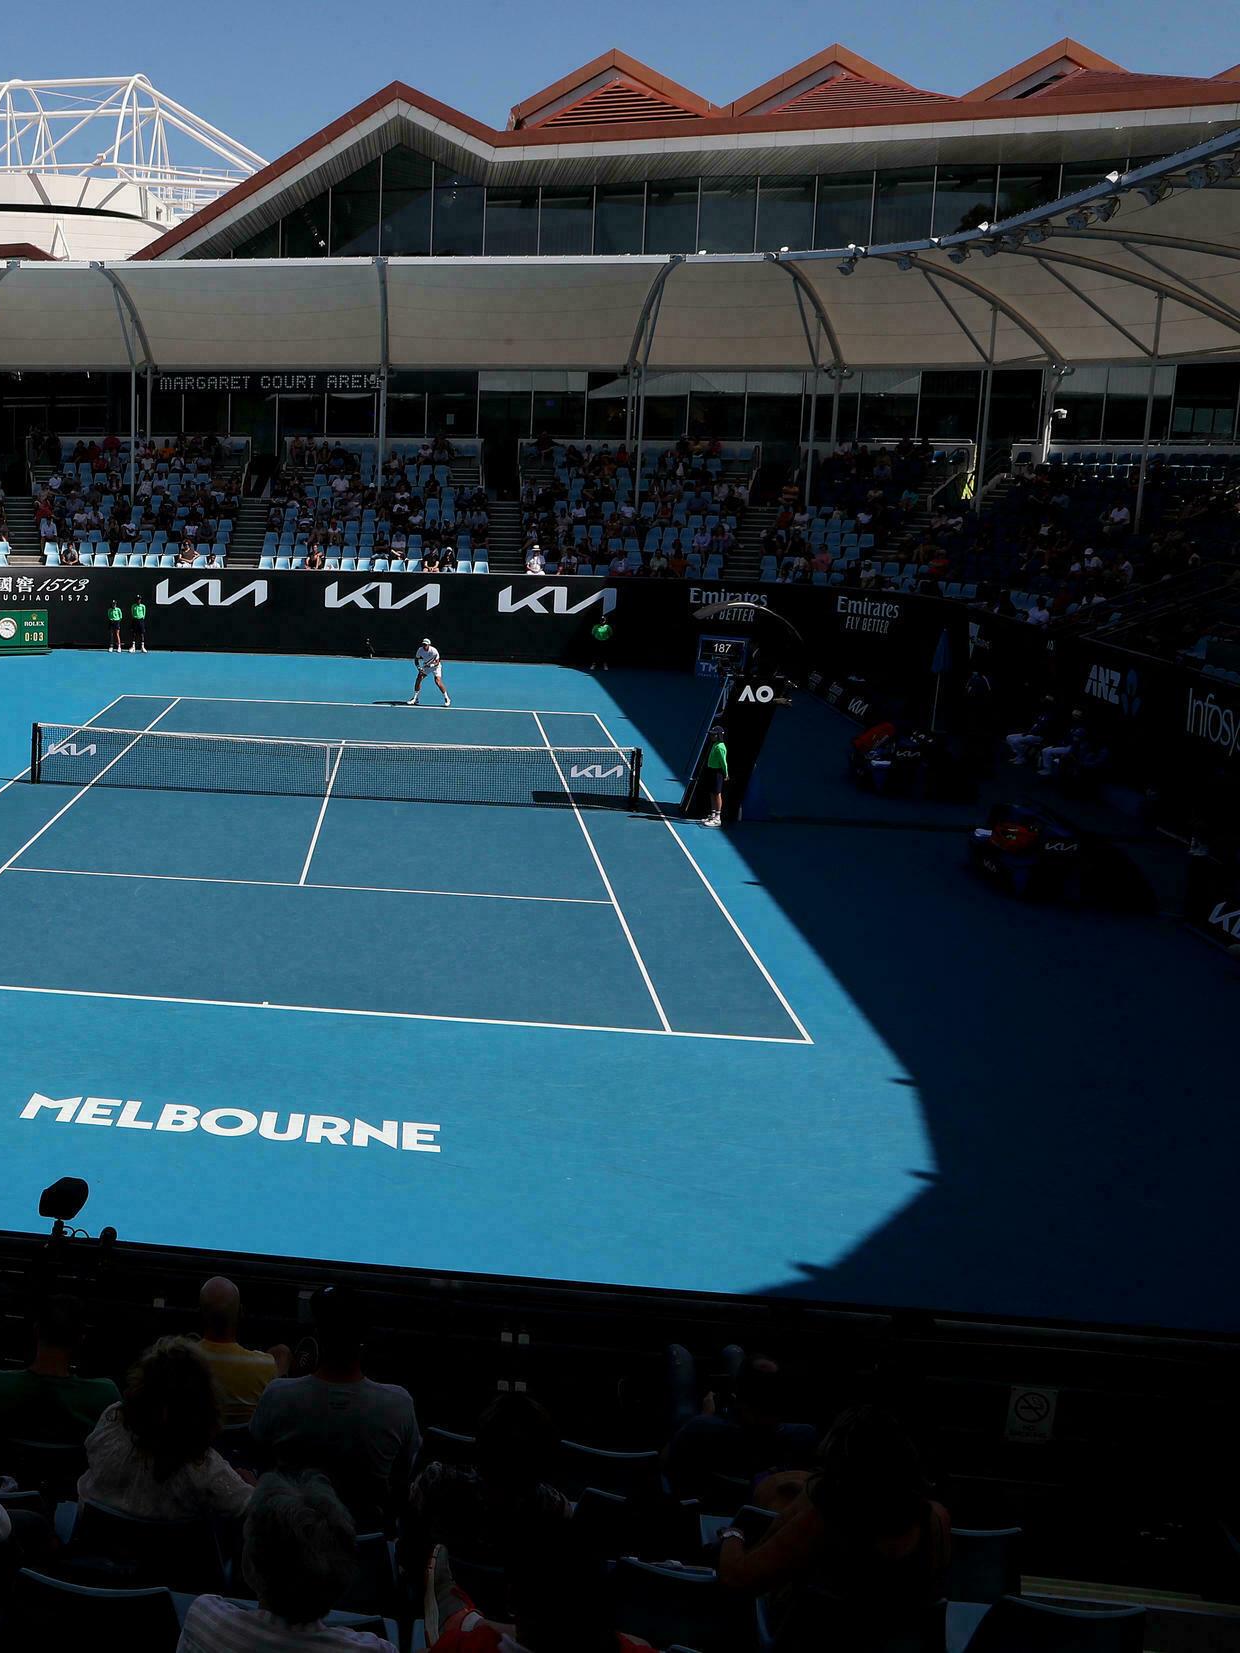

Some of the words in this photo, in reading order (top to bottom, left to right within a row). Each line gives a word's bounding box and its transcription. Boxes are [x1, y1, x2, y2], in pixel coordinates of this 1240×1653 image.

[160, 375, 250, 391] MARGARET
[260, 374, 317, 390] COURT
[60, 594, 89, 602] 1573
[156, 578, 268, 606] KIA
[324, 580, 441, 611] KIA
[498, 585, 618, 616] KIA
[688, 588, 768, 607] Emirates
[719, 608, 755, 622] BETTER
[837, 596, 900, 620] Emirates
[844, 616, 860, 630] FLY
[860, 618, 890, 634] BETTER
[24, 632, 44, 641] 0:03
[713, 643, 732, 653] 187
[1084, 664, 1122, 704] ANZ
[738, 685, 774, 703] AO
[1186, 688, 1240, 757] Infosy
[48, 741, 96, 757] KIA
[570, 764, 624, 779] KIA
[20, 1092, 442, 1153] MELBOURNE
